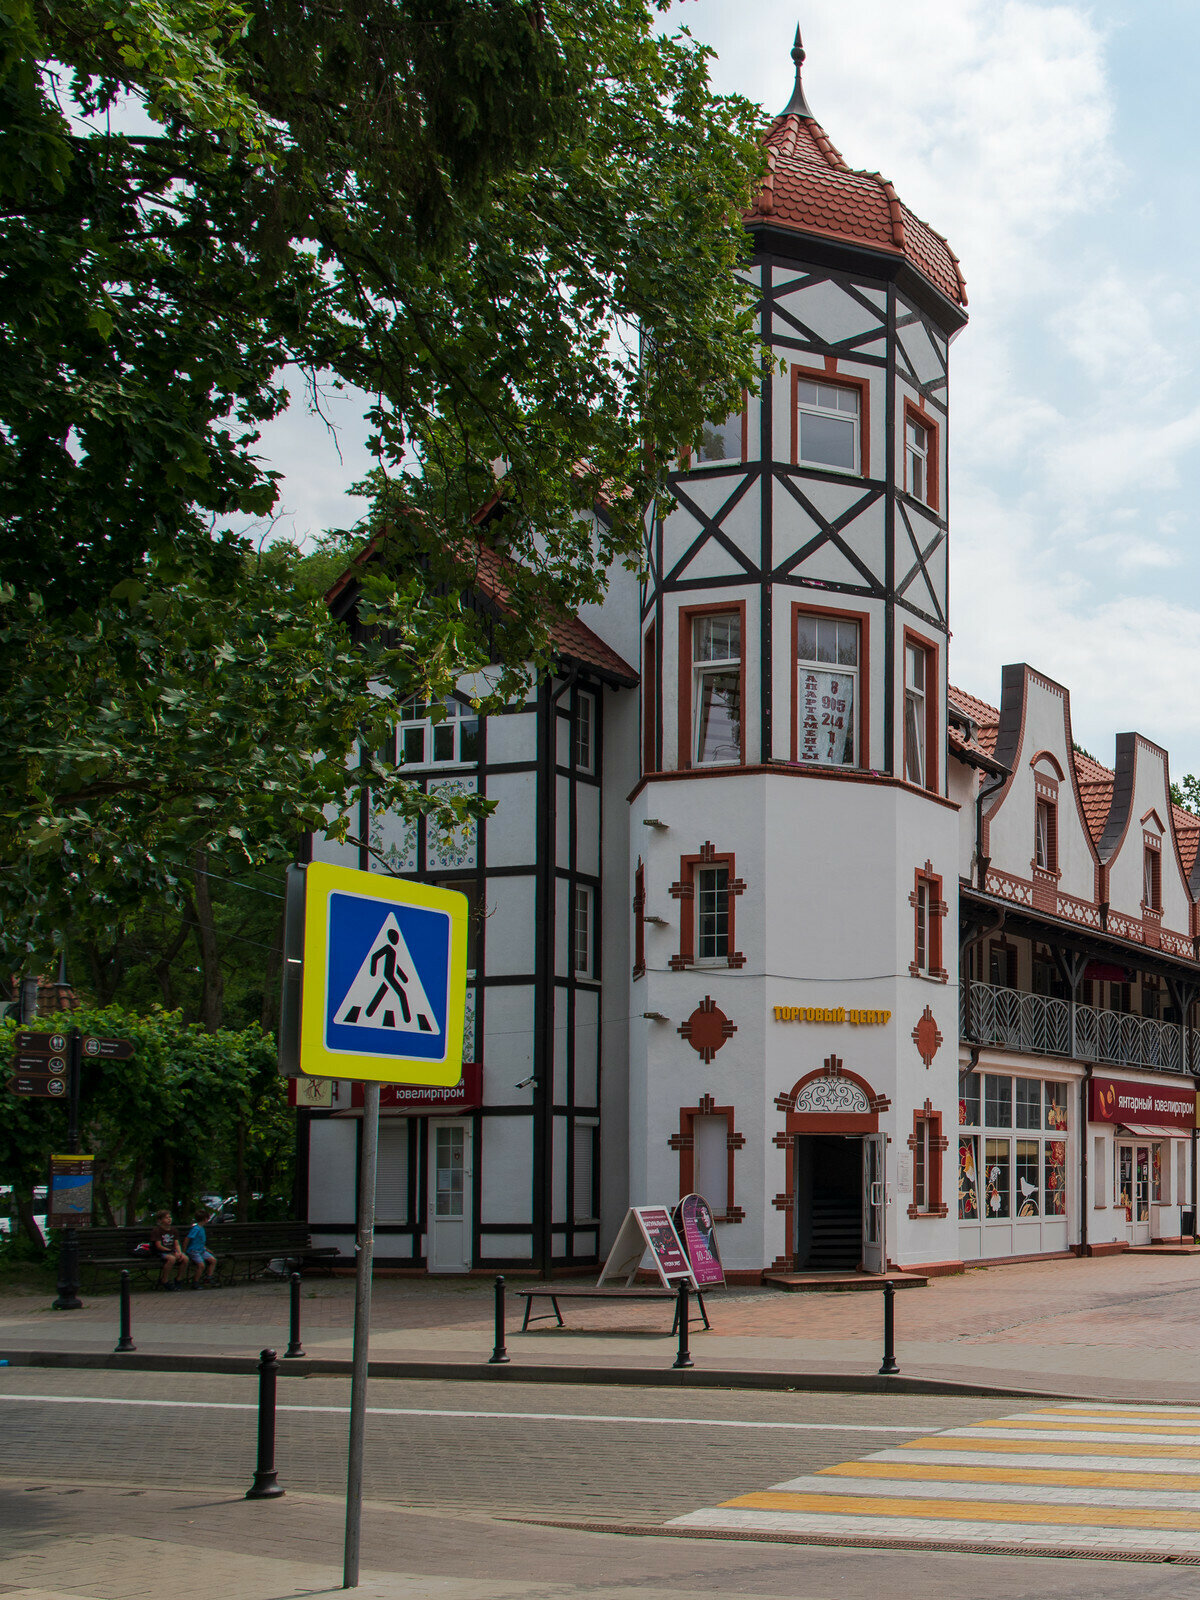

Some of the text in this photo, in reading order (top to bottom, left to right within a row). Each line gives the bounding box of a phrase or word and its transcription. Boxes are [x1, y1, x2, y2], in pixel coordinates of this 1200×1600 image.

[802, 675, 820, 760] АПАРТАМЕНТЫ
[773, 1006, 892, 1025] ТОРГОВЫЙ ЦЕНТР
[396, 1087, 465, 1102] ювелирпром
[1118, 1095, 1194, 1117] янтарный ювелирпром
